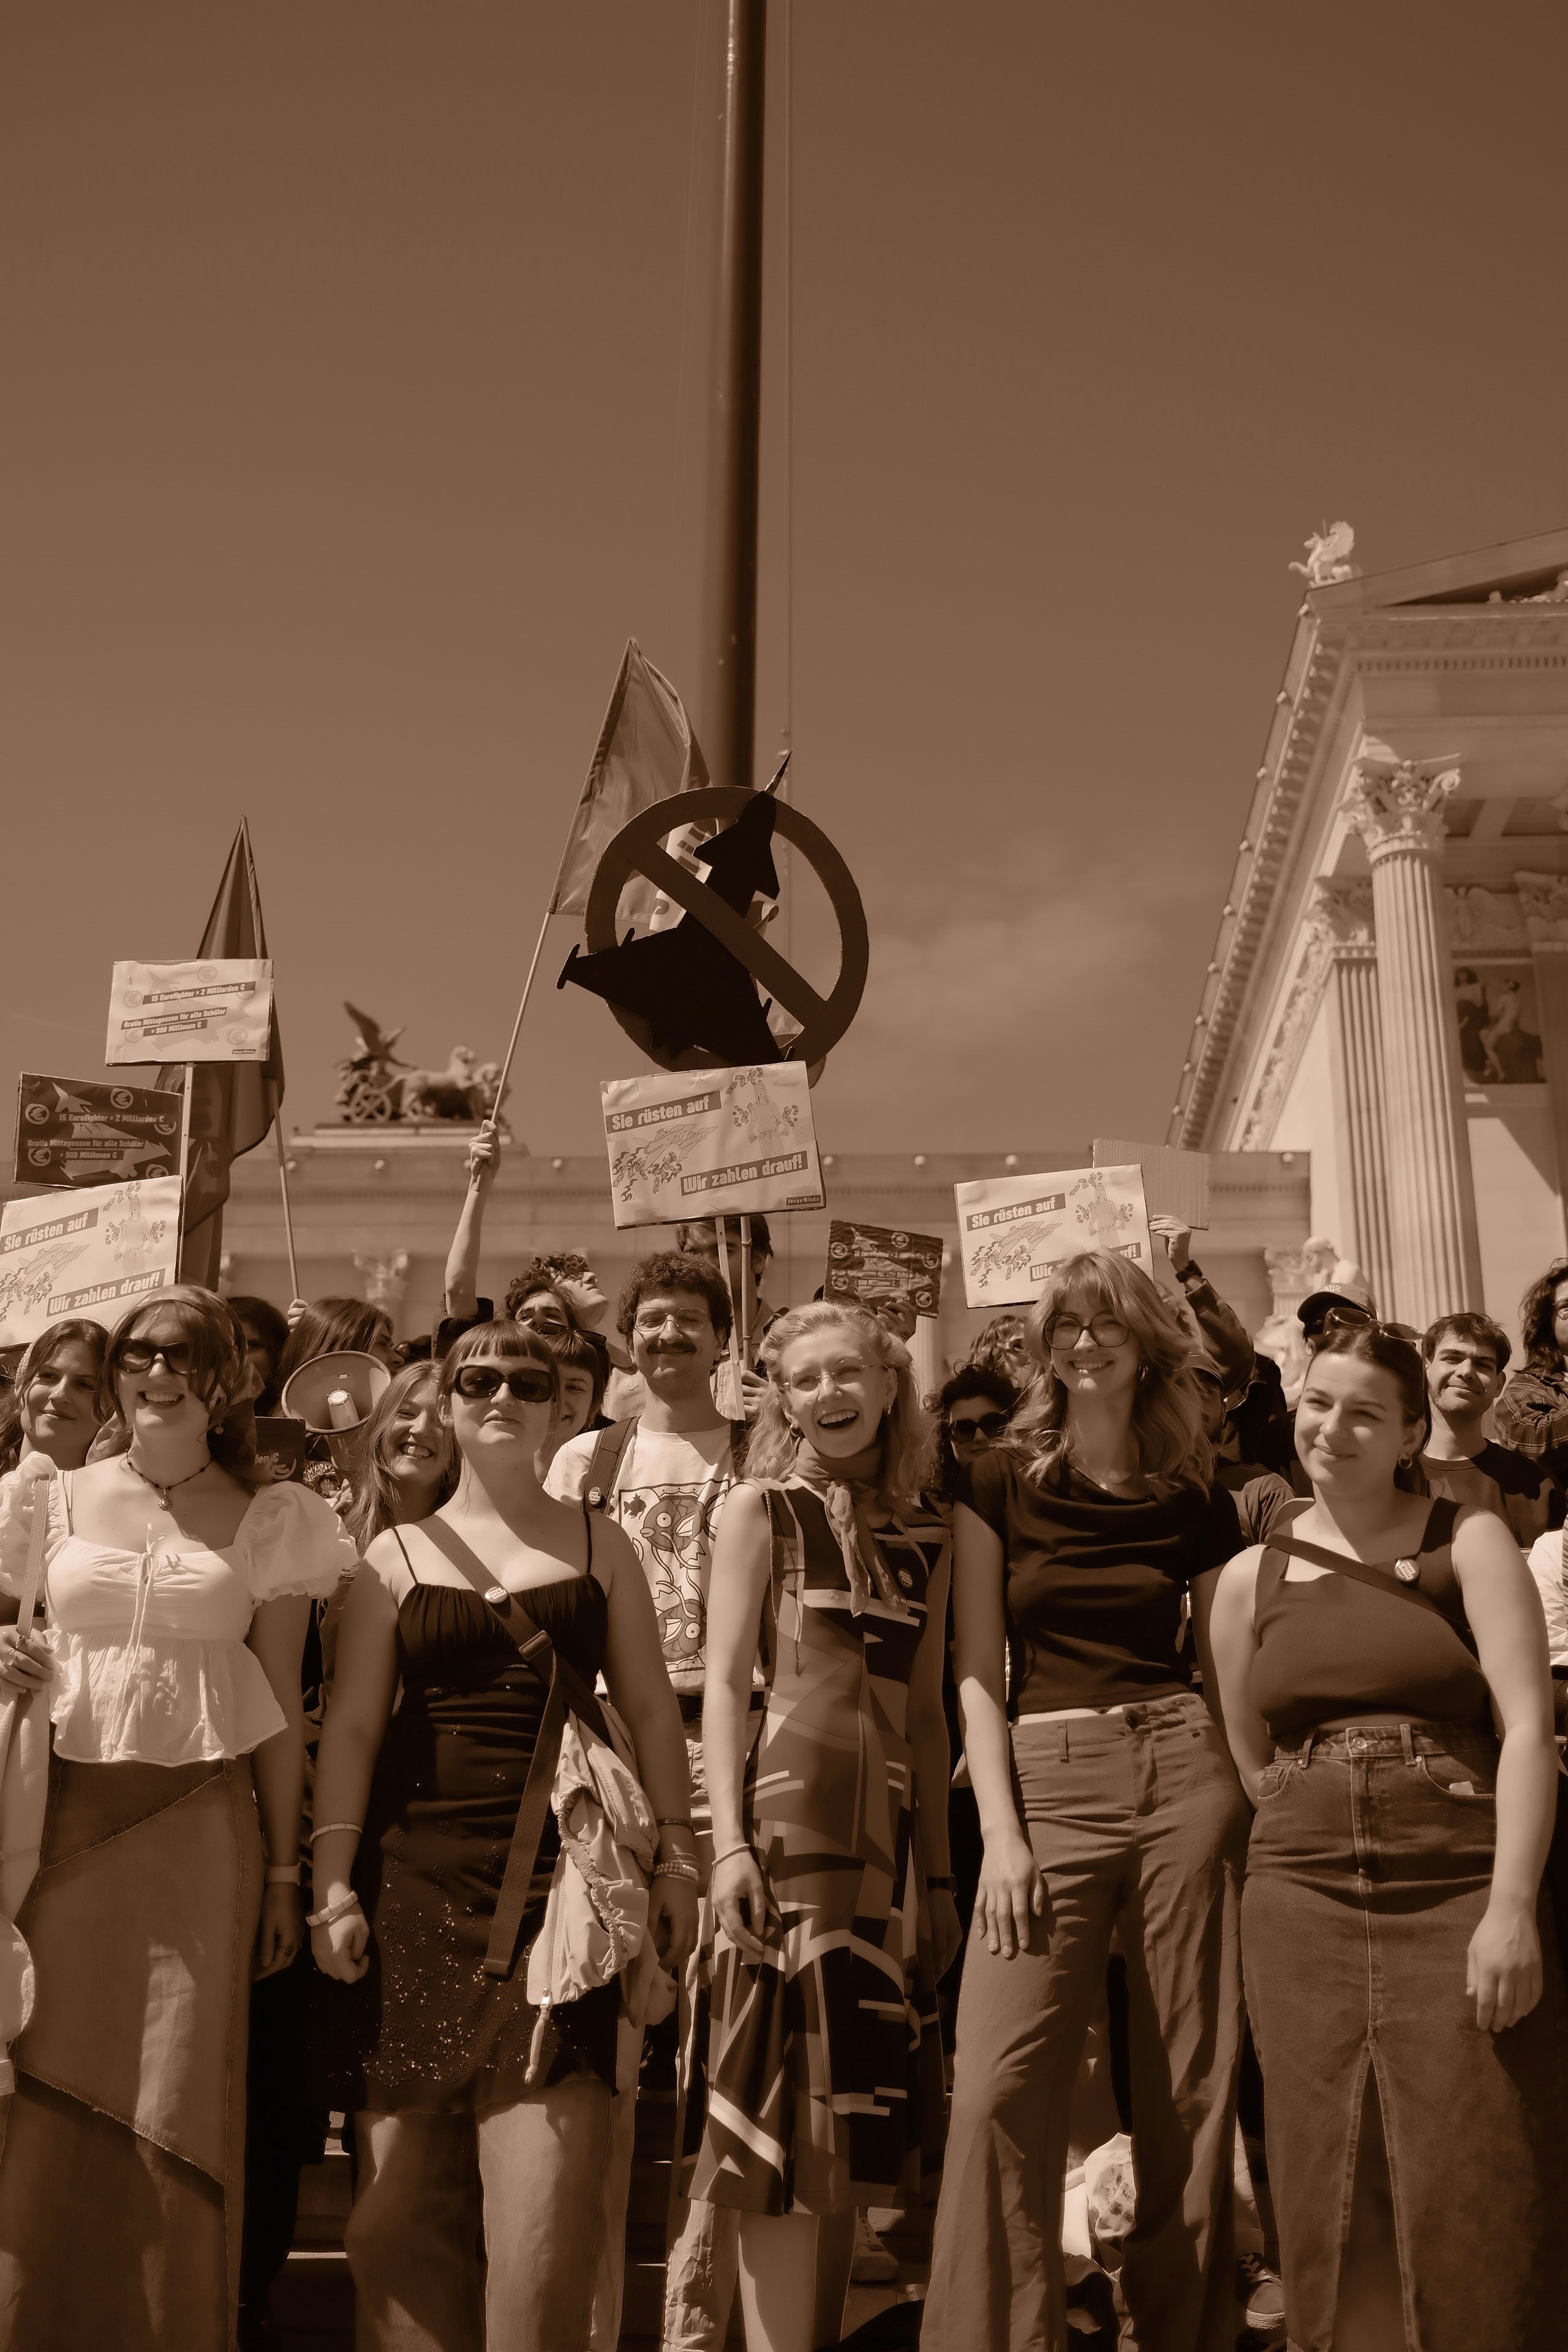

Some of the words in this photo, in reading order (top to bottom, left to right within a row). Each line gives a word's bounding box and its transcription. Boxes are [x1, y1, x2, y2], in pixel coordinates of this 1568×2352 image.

[160, 991, 194, 1001] Eurofighter
[207, 984, 239, 995] Milliarden
[124, 1020, 141, 1028] Gratis
[143, 1014, 178, 1026] Mittagessen
[203, 1007, 226, 1017] Schüler
[168, 1023, 196, 1032] Millionen
[69, 1114, 108, 1123] Eurofighter
[612, 1115, 633, 1131] Sie
[637, 1103, 682, 1125] rüsten
[687, 1095, 709, 1112] auf
[50, 1139, 91, 1148] Mittagessen
[682, 1177, 707, 1193] Wir
[712, 1165, 758, 1186] zahlen
[762, 1153, 802, 1176] drauf!
[971, 1214, 990, 1229] Sie
[993, 1204, 1032, 1224] rüsten
[1035, 1196, 1056, 1213] auf
[4, 1234, 21, 1251] Sie
[24, 1221, 62, 1245] rüsten
[67, 1213, 89, 1231] auf
[1031, 1264, 1052, 1280] Wir
[48, 1296, 71, 1314] Wir
[74, 1286, 116, 1308] zahlen
[120, 1271, 160, 1295] drauf!
